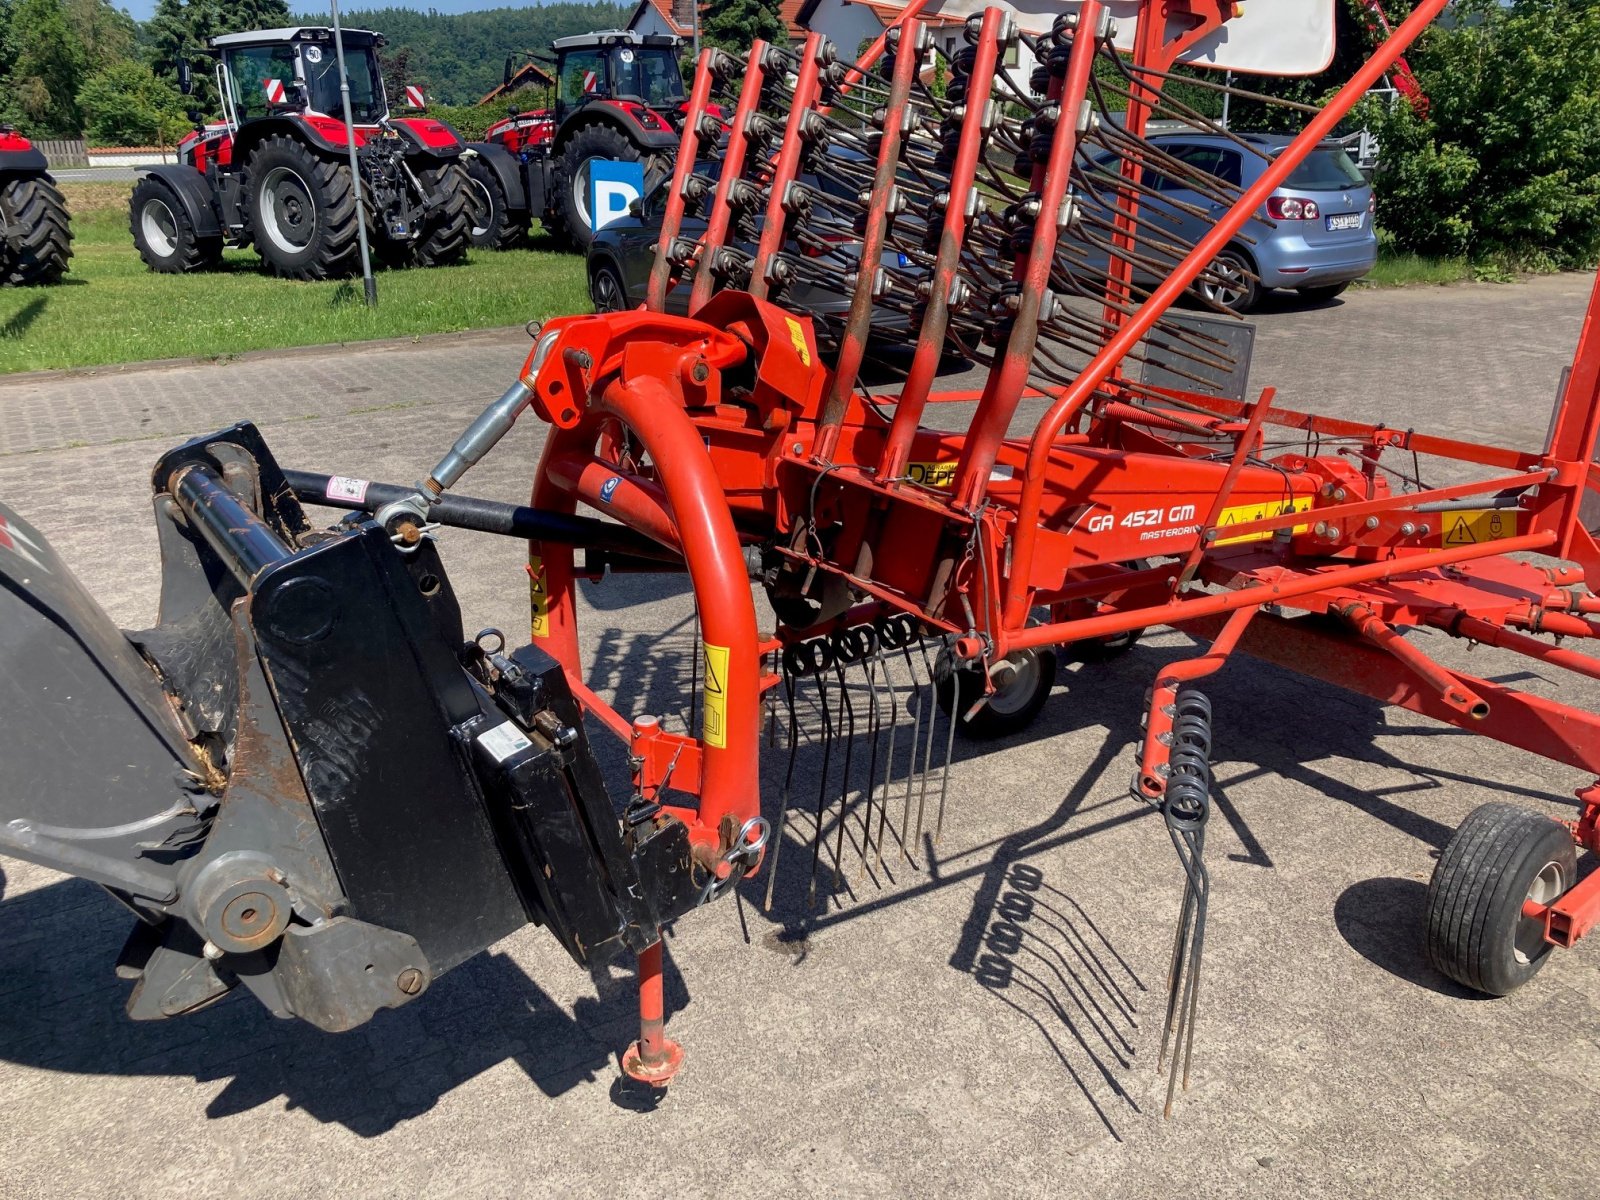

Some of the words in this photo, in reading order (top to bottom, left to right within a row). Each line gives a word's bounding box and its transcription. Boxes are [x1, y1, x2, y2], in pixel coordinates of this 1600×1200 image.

[595, 180, 640, 232] P
[1088, 514, 1115, 533] GA
[1120, 508, 1164, 528] 4521
[1168, 504, 1196, 522] GM
